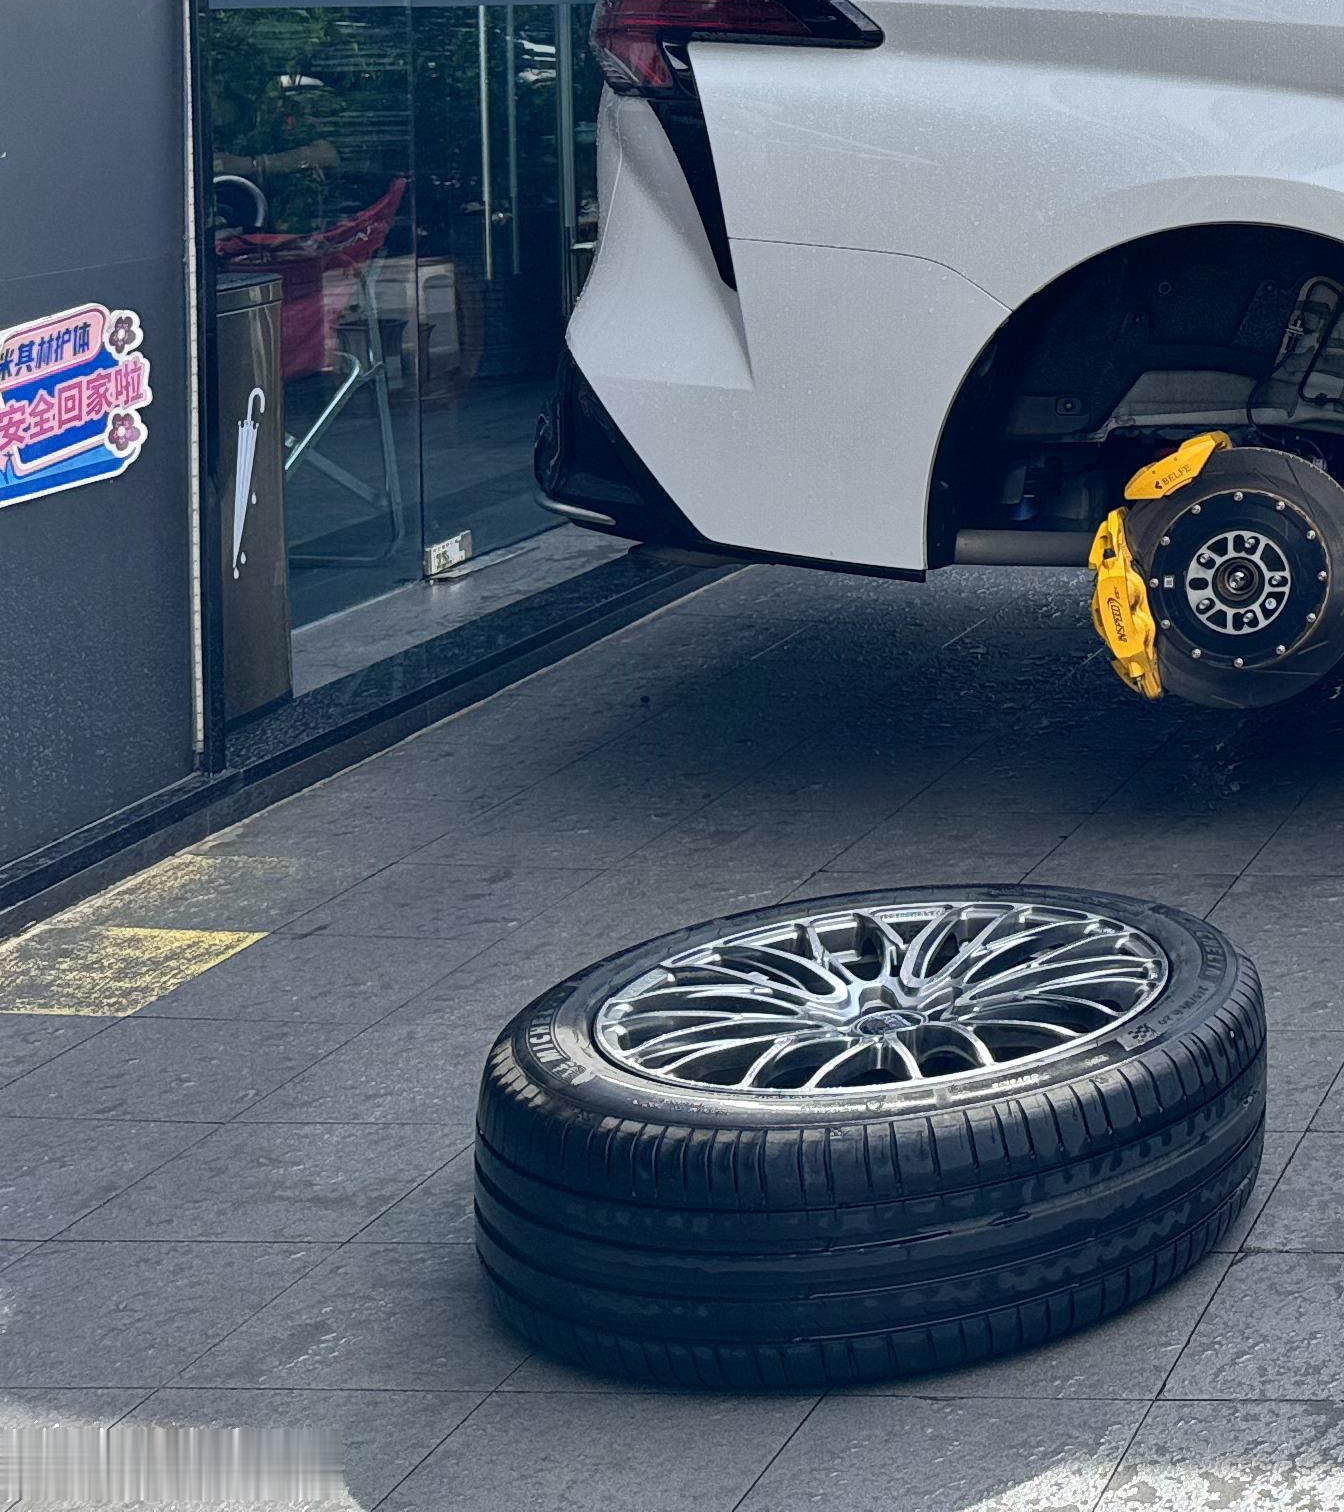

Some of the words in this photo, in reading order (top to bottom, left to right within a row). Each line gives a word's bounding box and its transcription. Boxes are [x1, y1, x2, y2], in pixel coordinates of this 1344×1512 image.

[0, 361, 144, 449] 安全回家啦
